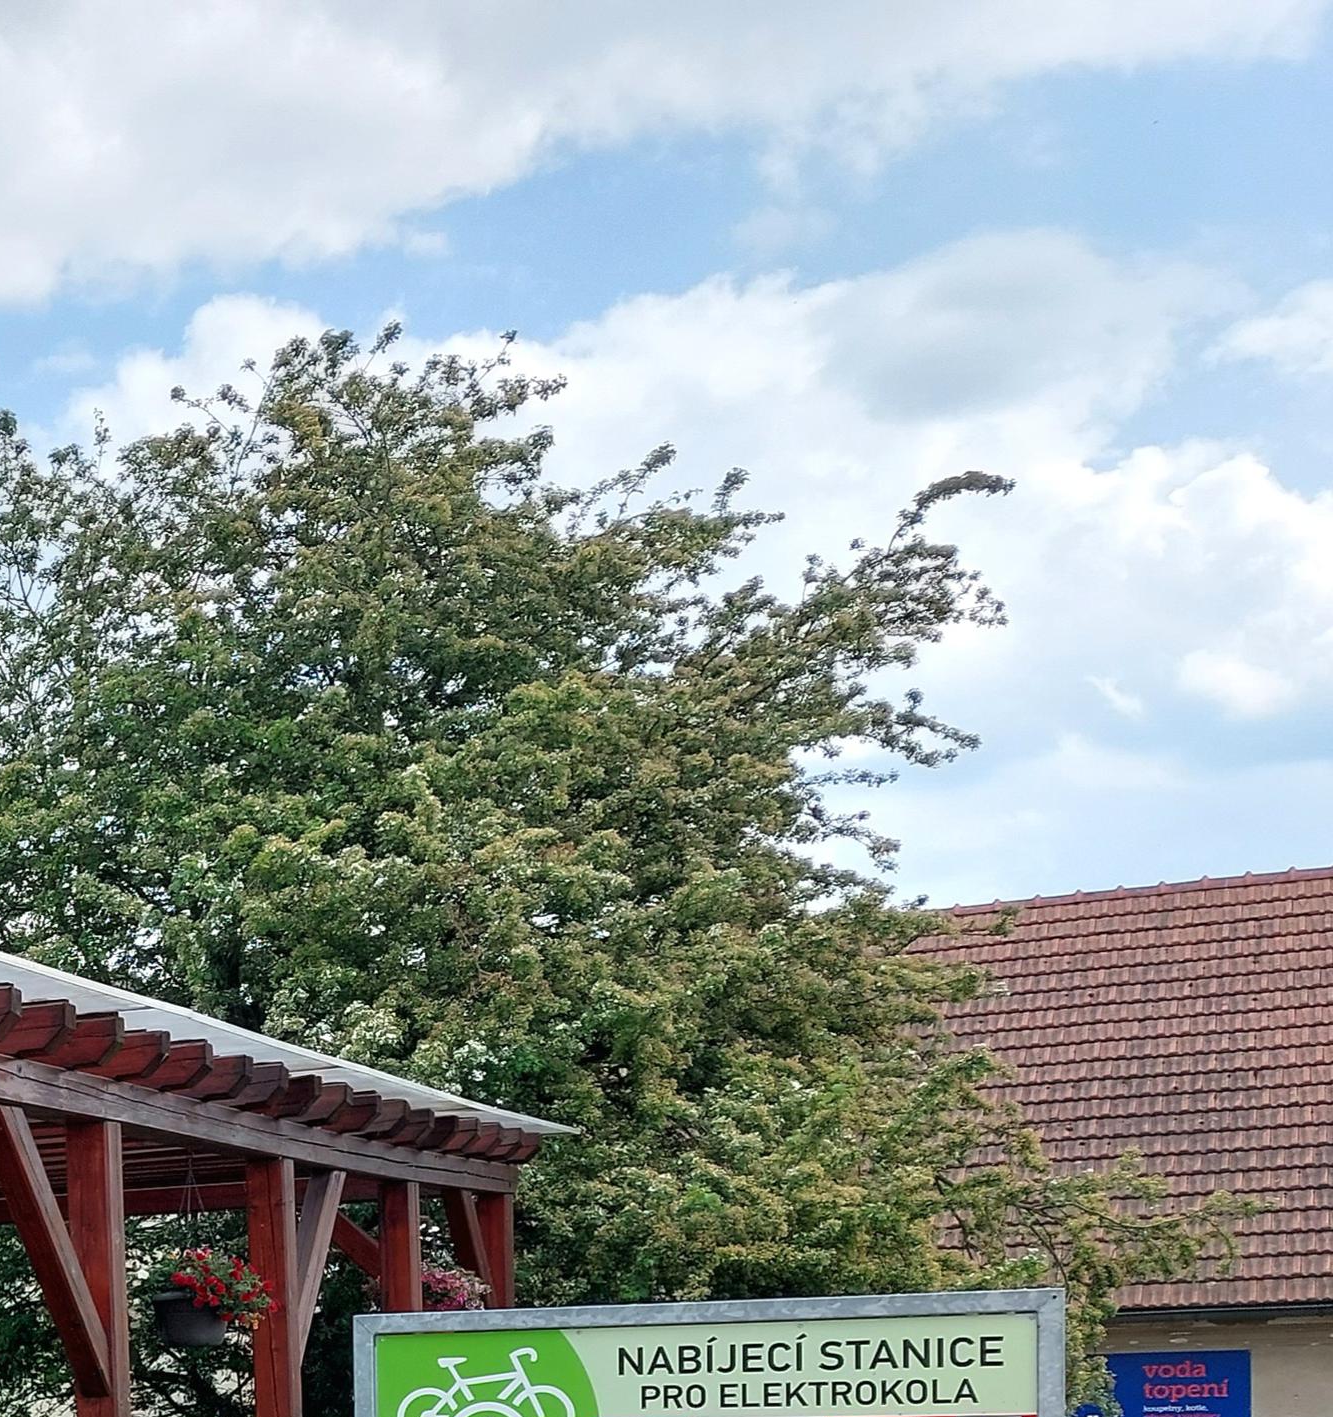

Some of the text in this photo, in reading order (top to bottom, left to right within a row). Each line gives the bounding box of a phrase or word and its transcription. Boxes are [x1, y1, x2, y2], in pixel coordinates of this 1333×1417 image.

[617, 1333, 1005, 1375] NABÍJECÍ STANICE
[1141, 1360, 1207, 1378] voda
[640, 1377, 979, 1409] PRO ELEKTROKOLA
[1143, 1377, 1229, 1402] topení
